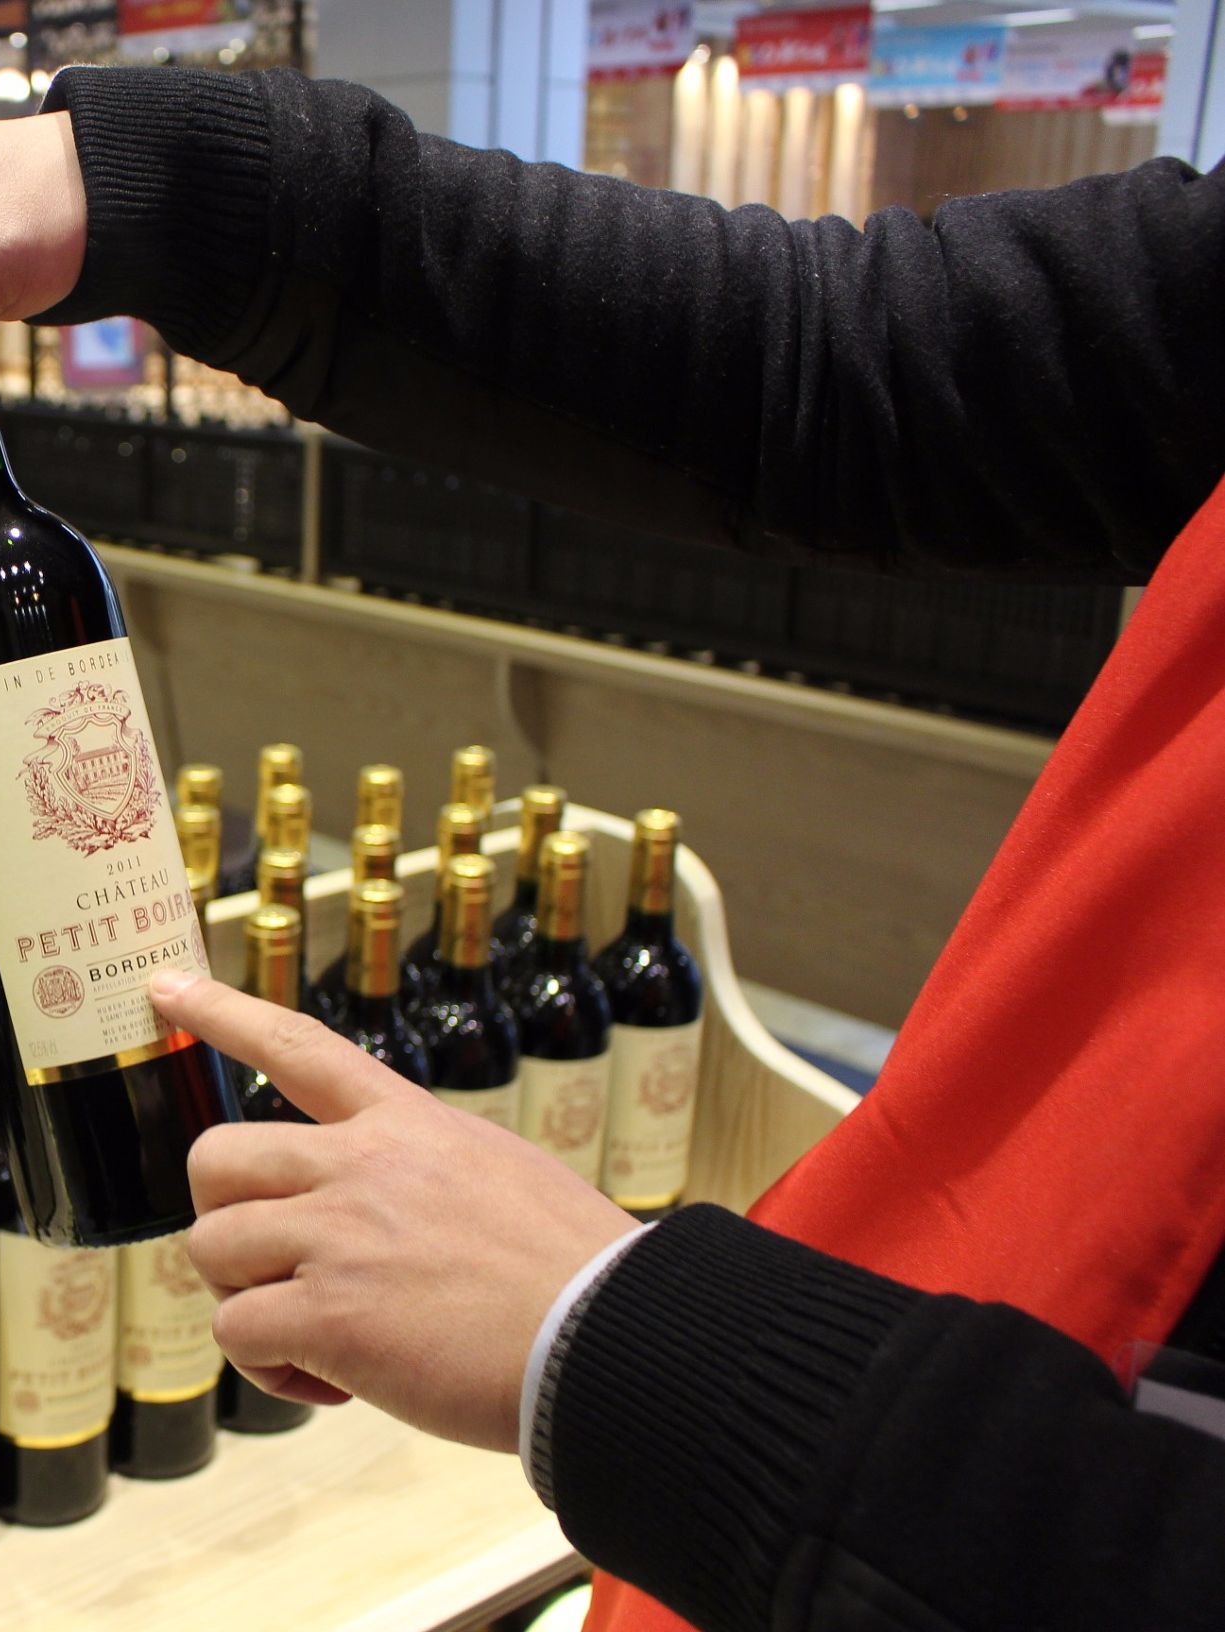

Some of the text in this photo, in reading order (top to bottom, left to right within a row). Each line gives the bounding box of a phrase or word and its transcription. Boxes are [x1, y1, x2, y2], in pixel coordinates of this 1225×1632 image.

[35, 669, 56, 684] DE
[67, 652, 130, 676] BORDEA
[106, 855, 142, 876] 2011
[76, 868, 169, 911] CHÂTEAU
[16, 913, 120, 964] PETIT
[89, 938, 190, 982] BORDEAUX
